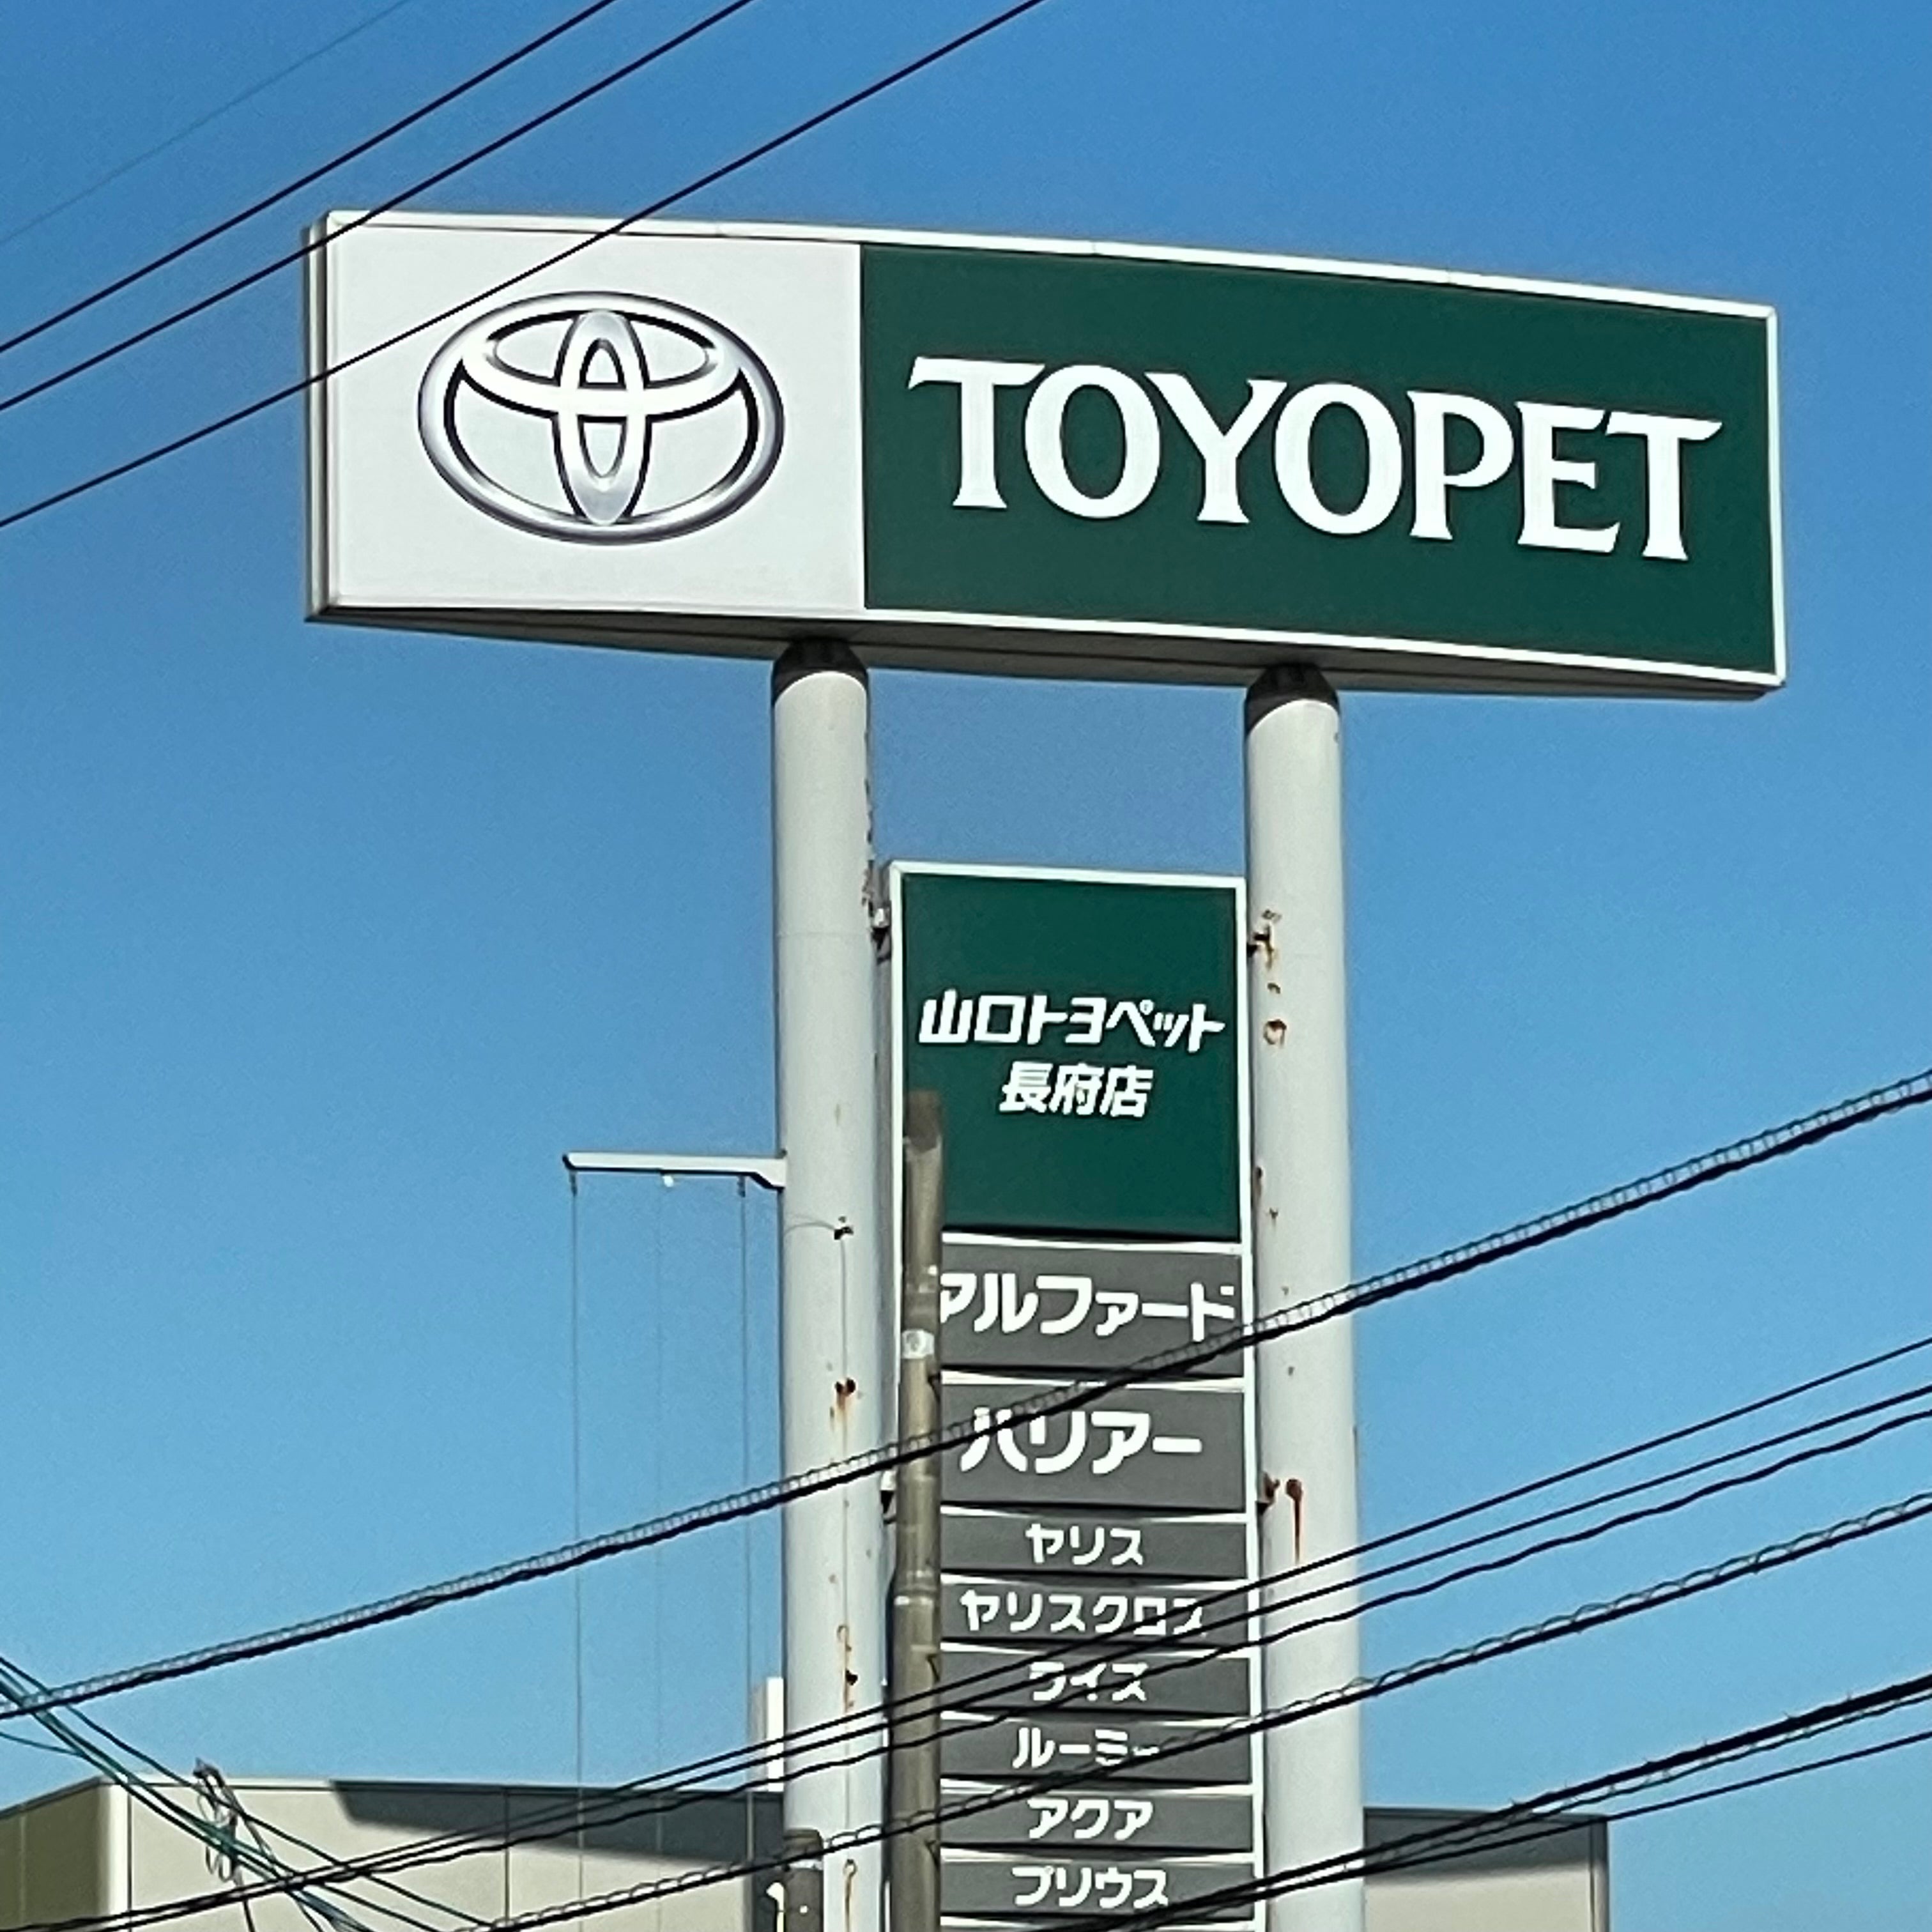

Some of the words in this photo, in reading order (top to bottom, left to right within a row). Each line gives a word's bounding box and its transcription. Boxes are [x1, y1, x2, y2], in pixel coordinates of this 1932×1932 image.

[908, 356, 1722, 560] TOYOPET
[919, 989, 1225, 1052] 山口トヨペット
[999, 1061, 1153, 1117] 長府店
[940, 1273, 1235, 1342] アルファード
[960, 1407, 1202, 1474] ハリアー
[1025, 1523, 1143, 1565] ヤリス
[960, 1590, 1206, 1637] ヤリスクロス
[1012, 1727, 1160, 1767] ルーミー
[1027, 1798, 1153, 1841] アクア
[1012, 1867, 1169, 1909] プリウス
